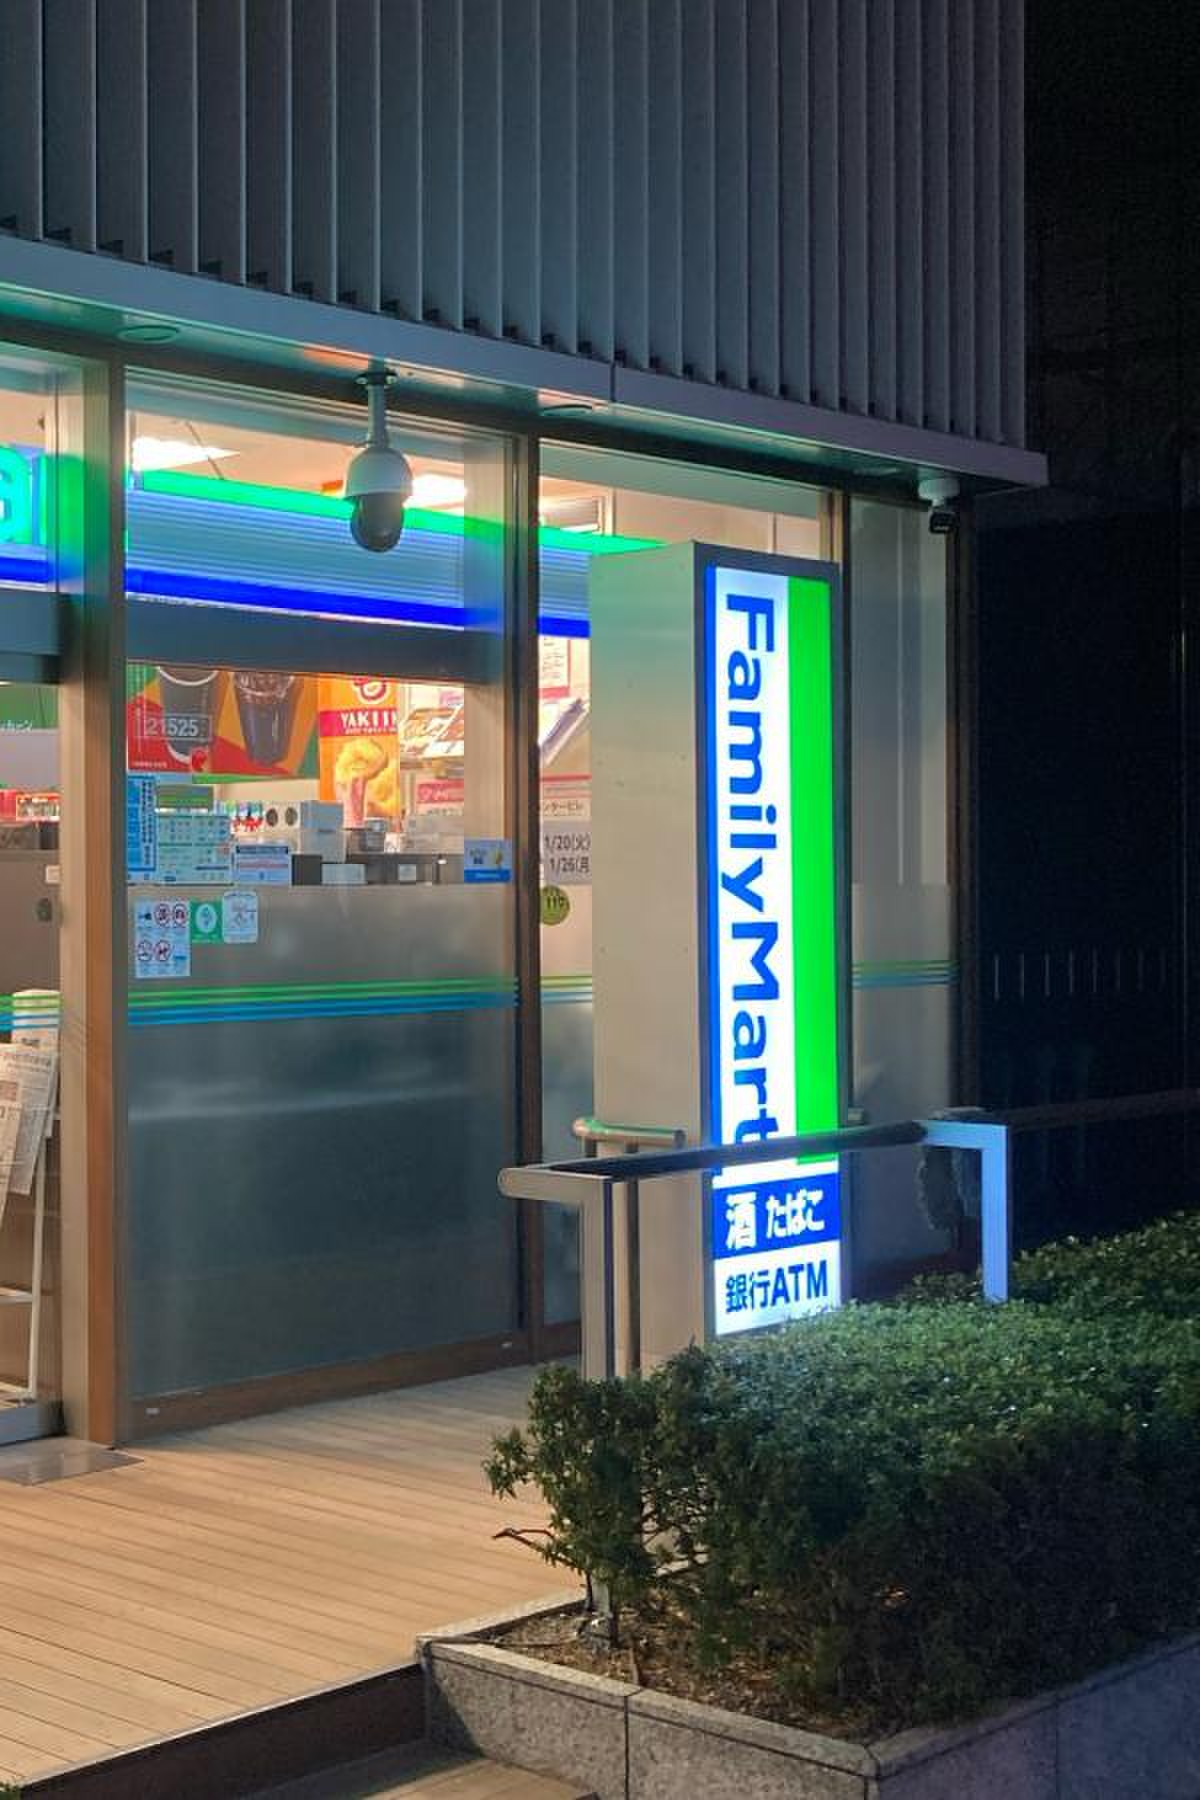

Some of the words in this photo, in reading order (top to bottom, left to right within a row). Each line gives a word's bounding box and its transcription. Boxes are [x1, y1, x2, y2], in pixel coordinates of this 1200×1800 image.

[719, 593, 779, 1146] FamilyMart
[726, 1192, 757, 1249] 酒
[766, 1189, 825, 1239] たばこ
[726, 1260, 828, 1314] 銀行ATM
